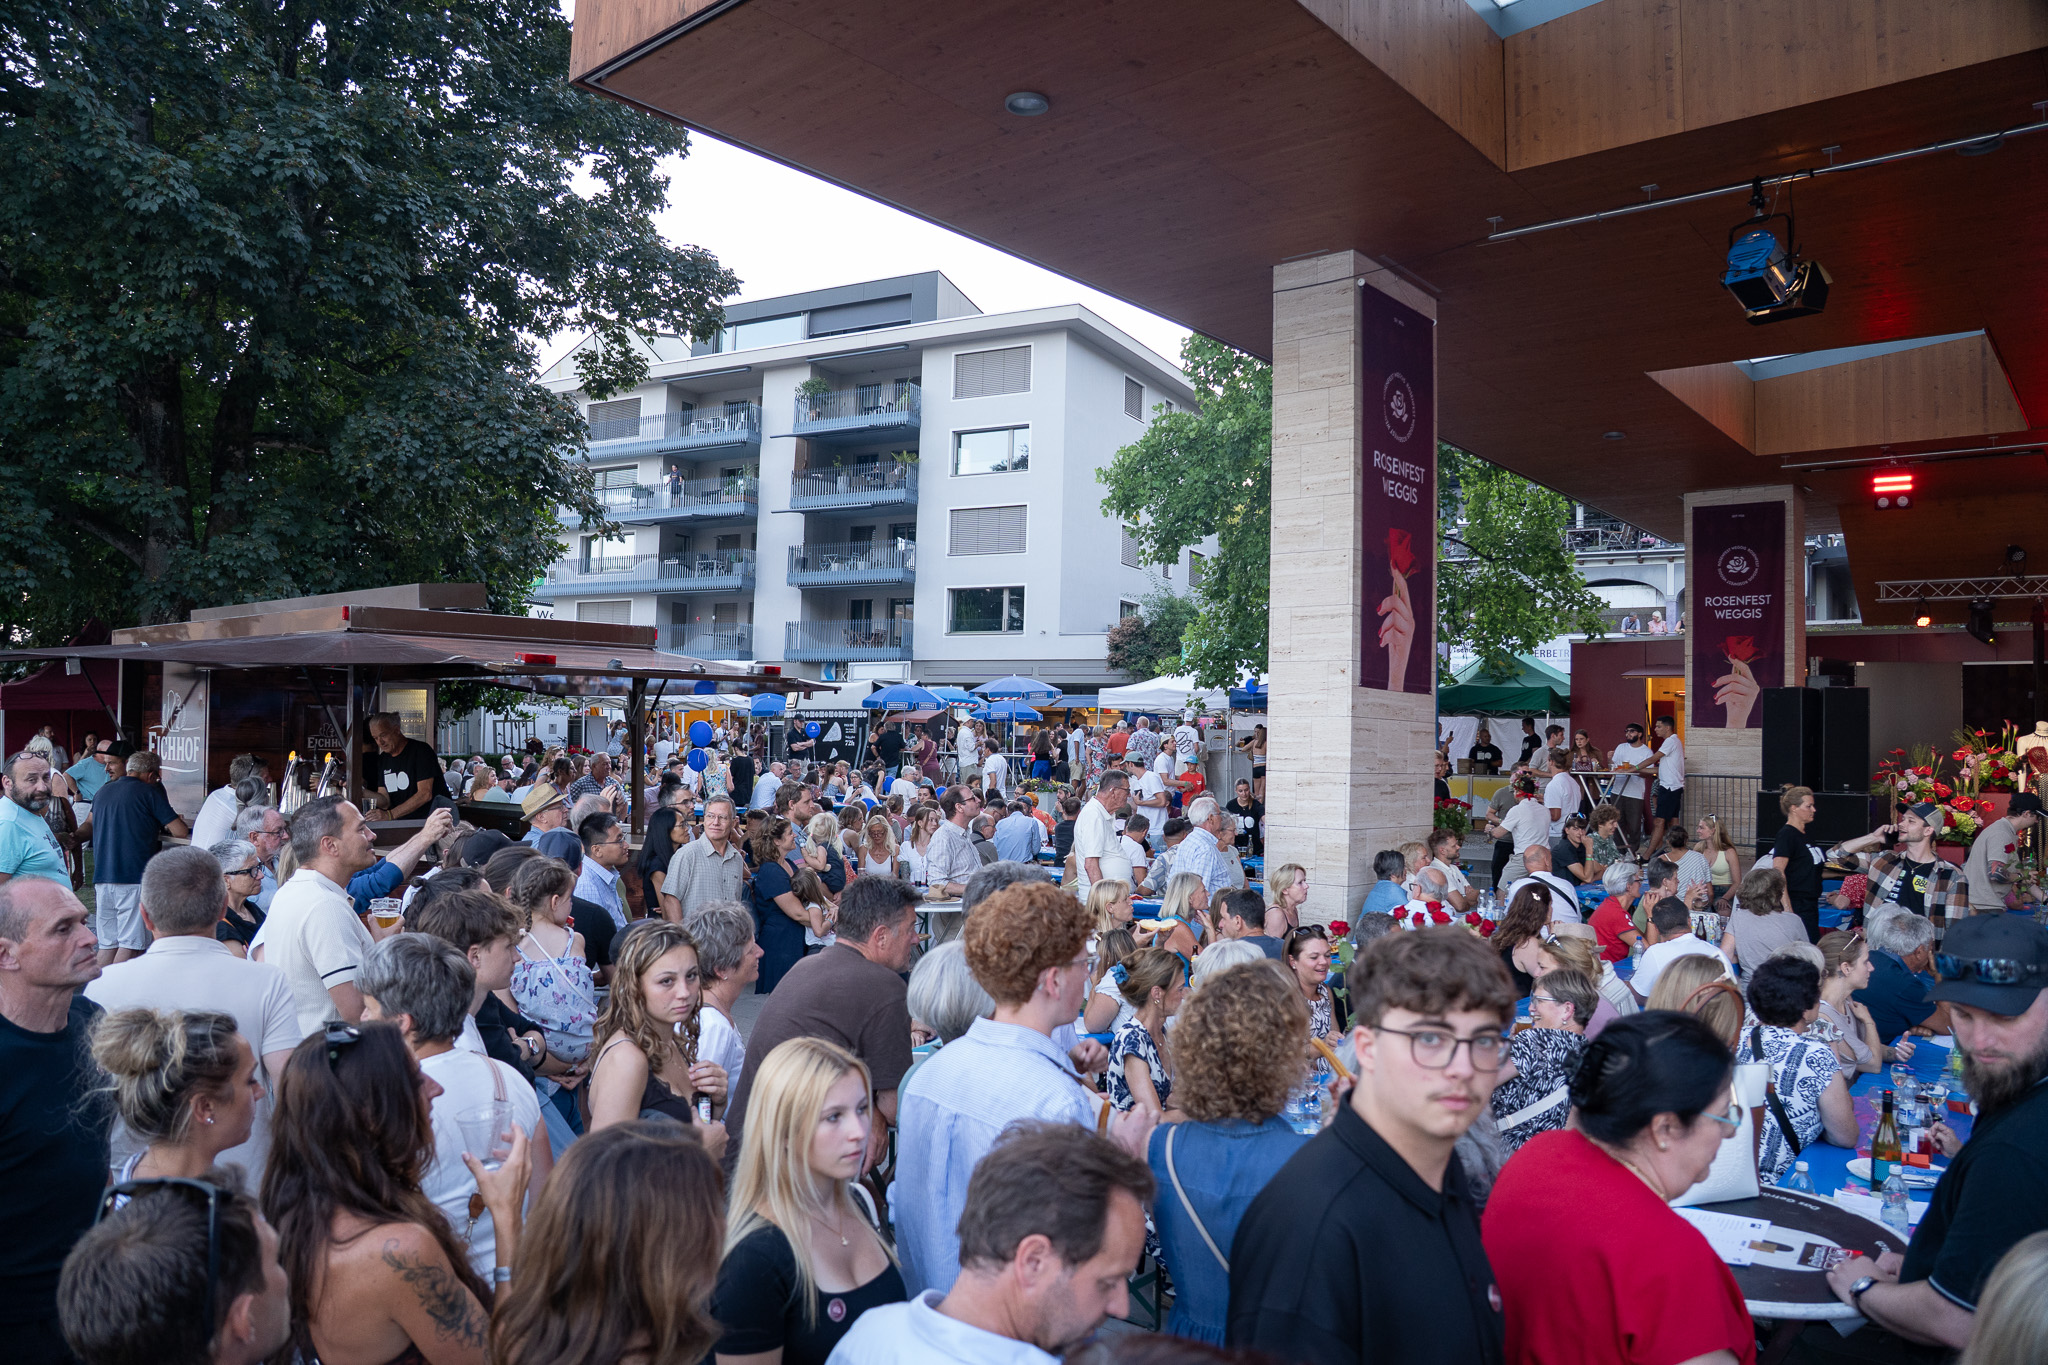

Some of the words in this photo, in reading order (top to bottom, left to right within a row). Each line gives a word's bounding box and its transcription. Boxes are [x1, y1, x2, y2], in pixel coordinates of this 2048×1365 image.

[1374, 450, 1425, 484] ROSENFEST
[1382, 476, 1418, 504] WEGGIS
[1705, 594, 1772, 607] ROSENFEST
[1714, 608, 1762, 619] WEGGIS
[148, 731, 200, 763] EICHHOF
[1798, 1201, 1821, 1211] Das
